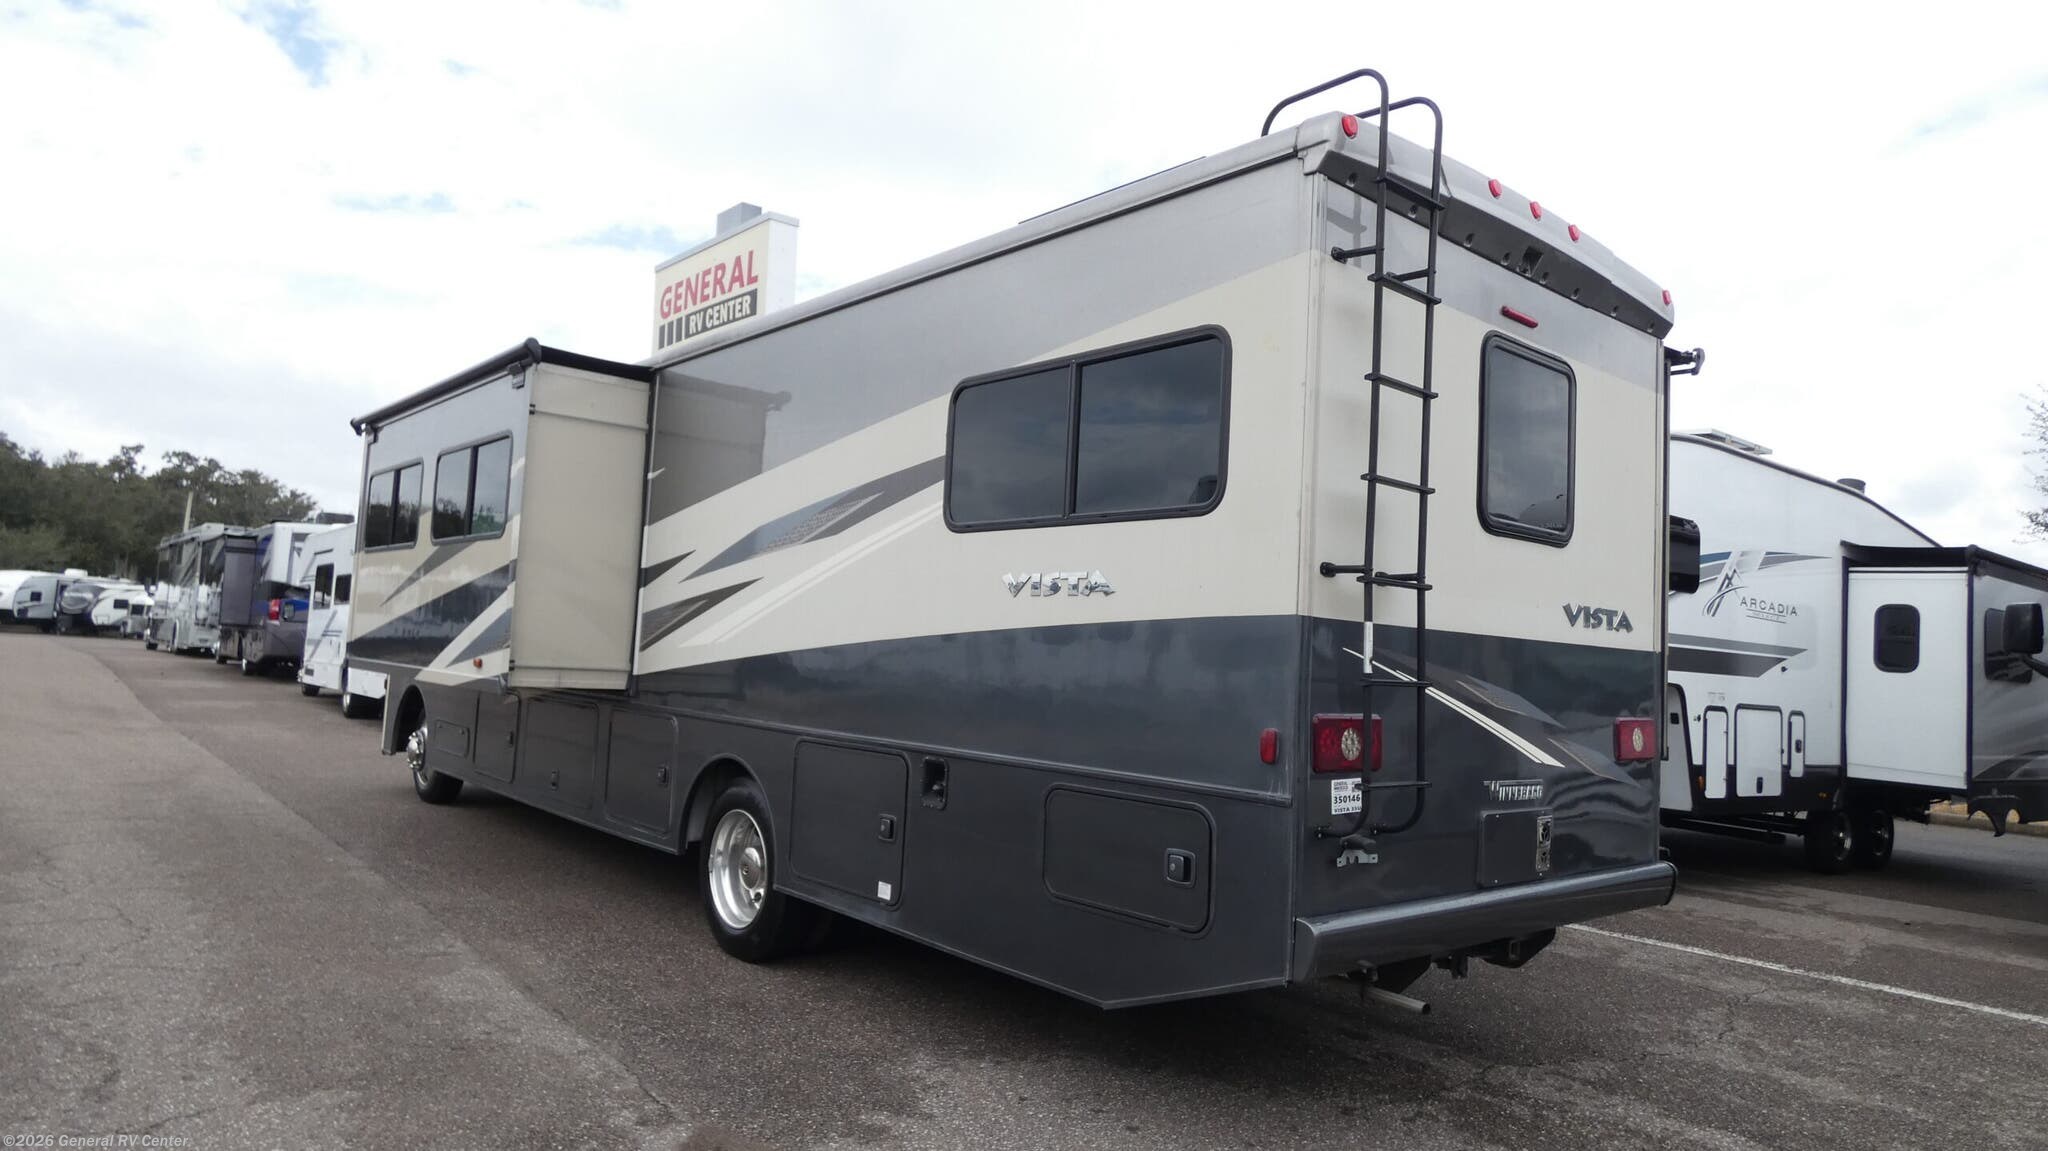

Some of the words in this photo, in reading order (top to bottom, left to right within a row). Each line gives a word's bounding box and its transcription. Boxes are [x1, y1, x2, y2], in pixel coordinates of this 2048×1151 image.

[660, 249, 758, 319] GENERAL
[689, 311, 703, 335] RV
[705, 294, 751, 329] CENTER
[1001, 569, 1115, 598] VISTA
[1562, 602, 1634, 633] VISTA
[1740, 596, 1798, 617] ARCADIA
[1333, 793, 1361, 805] 350146
